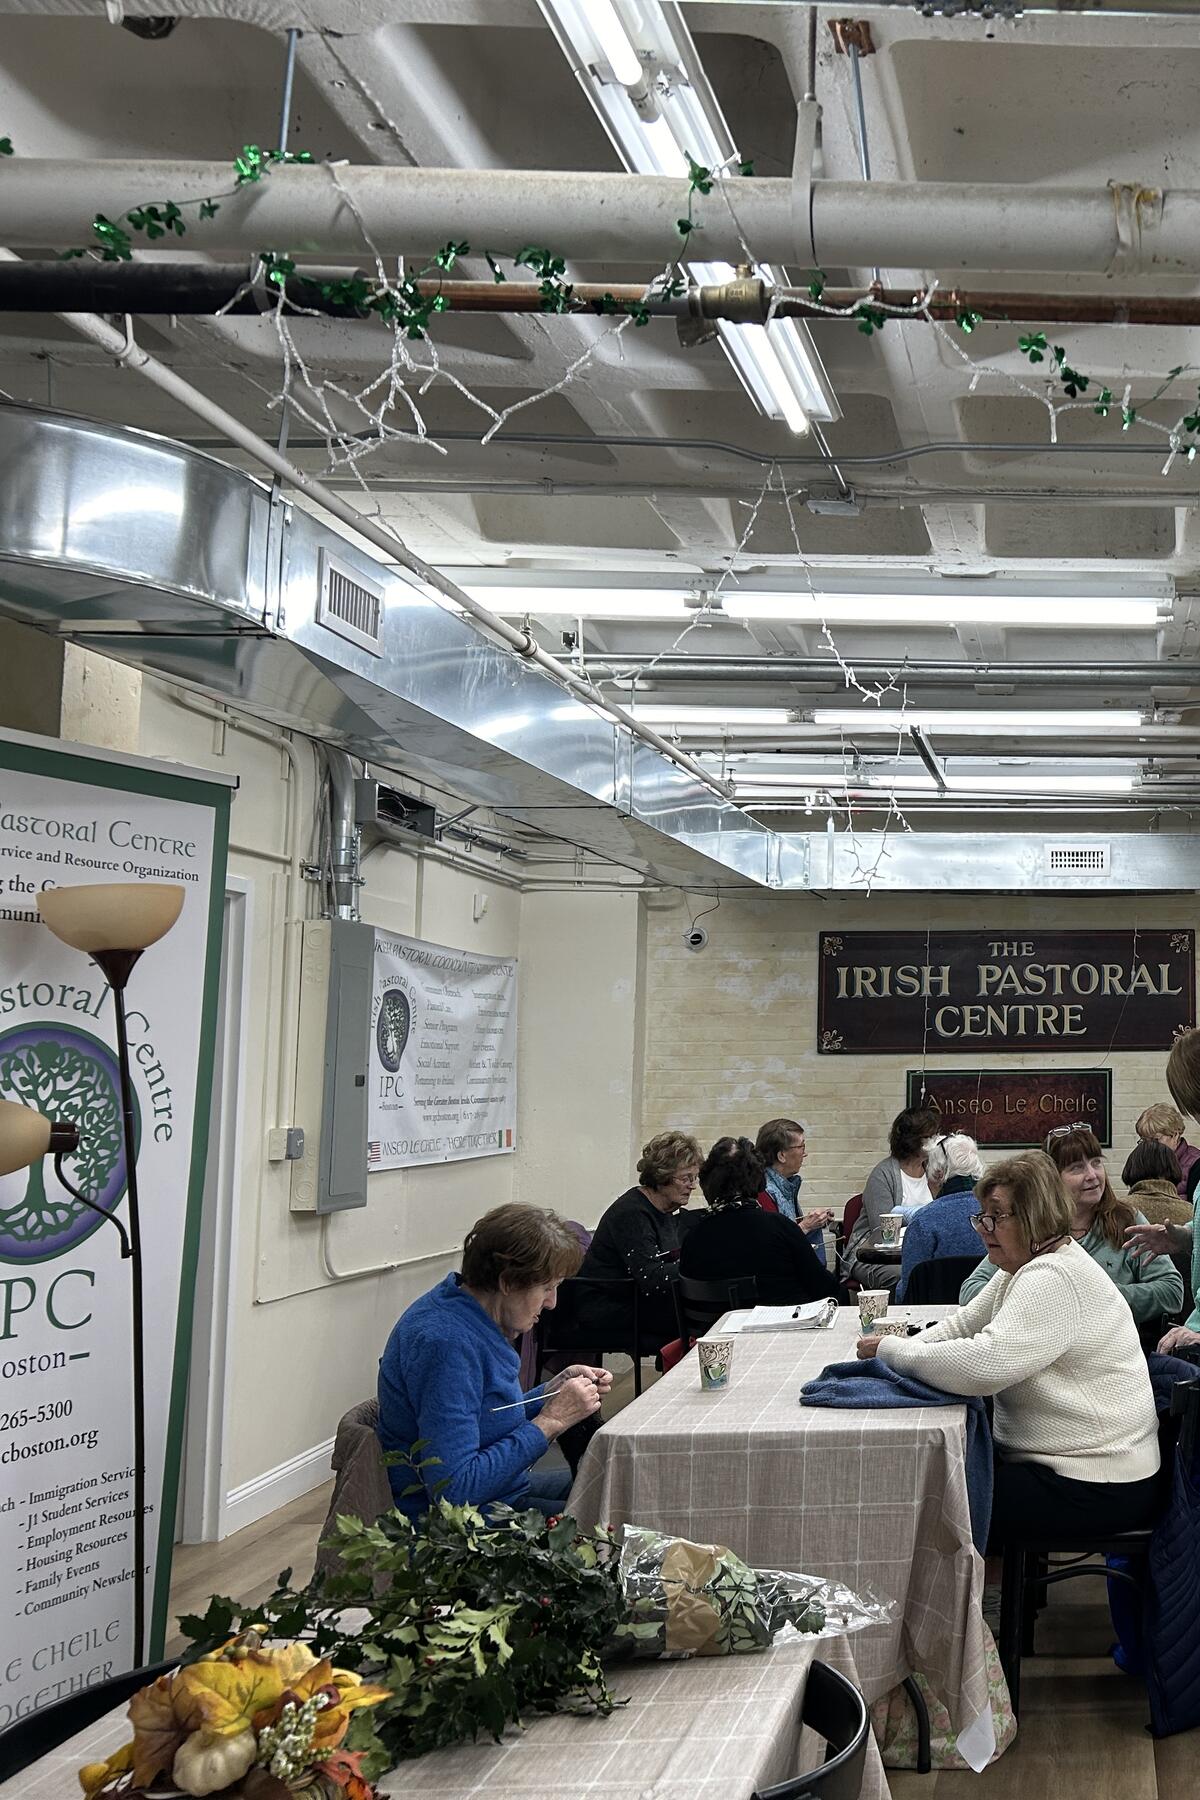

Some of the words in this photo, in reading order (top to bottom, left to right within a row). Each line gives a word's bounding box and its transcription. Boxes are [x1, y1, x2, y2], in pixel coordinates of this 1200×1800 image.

[108, 820, 197, 858] Centre
[8, 874, 36, 894] the
[36, 850, 61, 864] and
[64, 852, 119, 872] Resource
[122, 860, 200, 883] Organization
[0, 907, 46, 925] muni
[988, 941, 1036, 958] THE
[836, 964, 951, 999] IRISH
[976, 962, 1183, 997] PASTORAL
[0, 982, 110, 1019] storal
[934, 1003, 1087, 1038] CENTRE
[379, 1075, 405, 1098] IPC
[927, 1094, 993, 1115] Anseo
[1005, 1095, 1026, 1113] Le
[1038, 1093, 1097, 1113] Cheile
[0, 1269, 95, 1340] PC
[0, 1399, 73, 1431] 265-5300
[1, 1429, 99, 1465] cboston.org
[29, 1478, 98, 1505] Immigration
[101, 1464, 146, 1485] Servic
[26, 1513, 38, 1533] J1
[41, 1502, 82, 1523] Student
[85, 1489, 130, 1511] Services
[25, 1549, 73, 1572] Housing
[75, 1531, 129, 1556] Resources
[26, 1519, 97, 1550] Employment
[24, 1570, 64, 1594] Family
[66, 1560, 101, 1580] Events
[24, 1584, 90, 1616] Community
[92, 1565, 151, 1594] Newsletr
[0, 1657, 22, 1688] E
[32, 1619, 120, 1672] CHEILE
